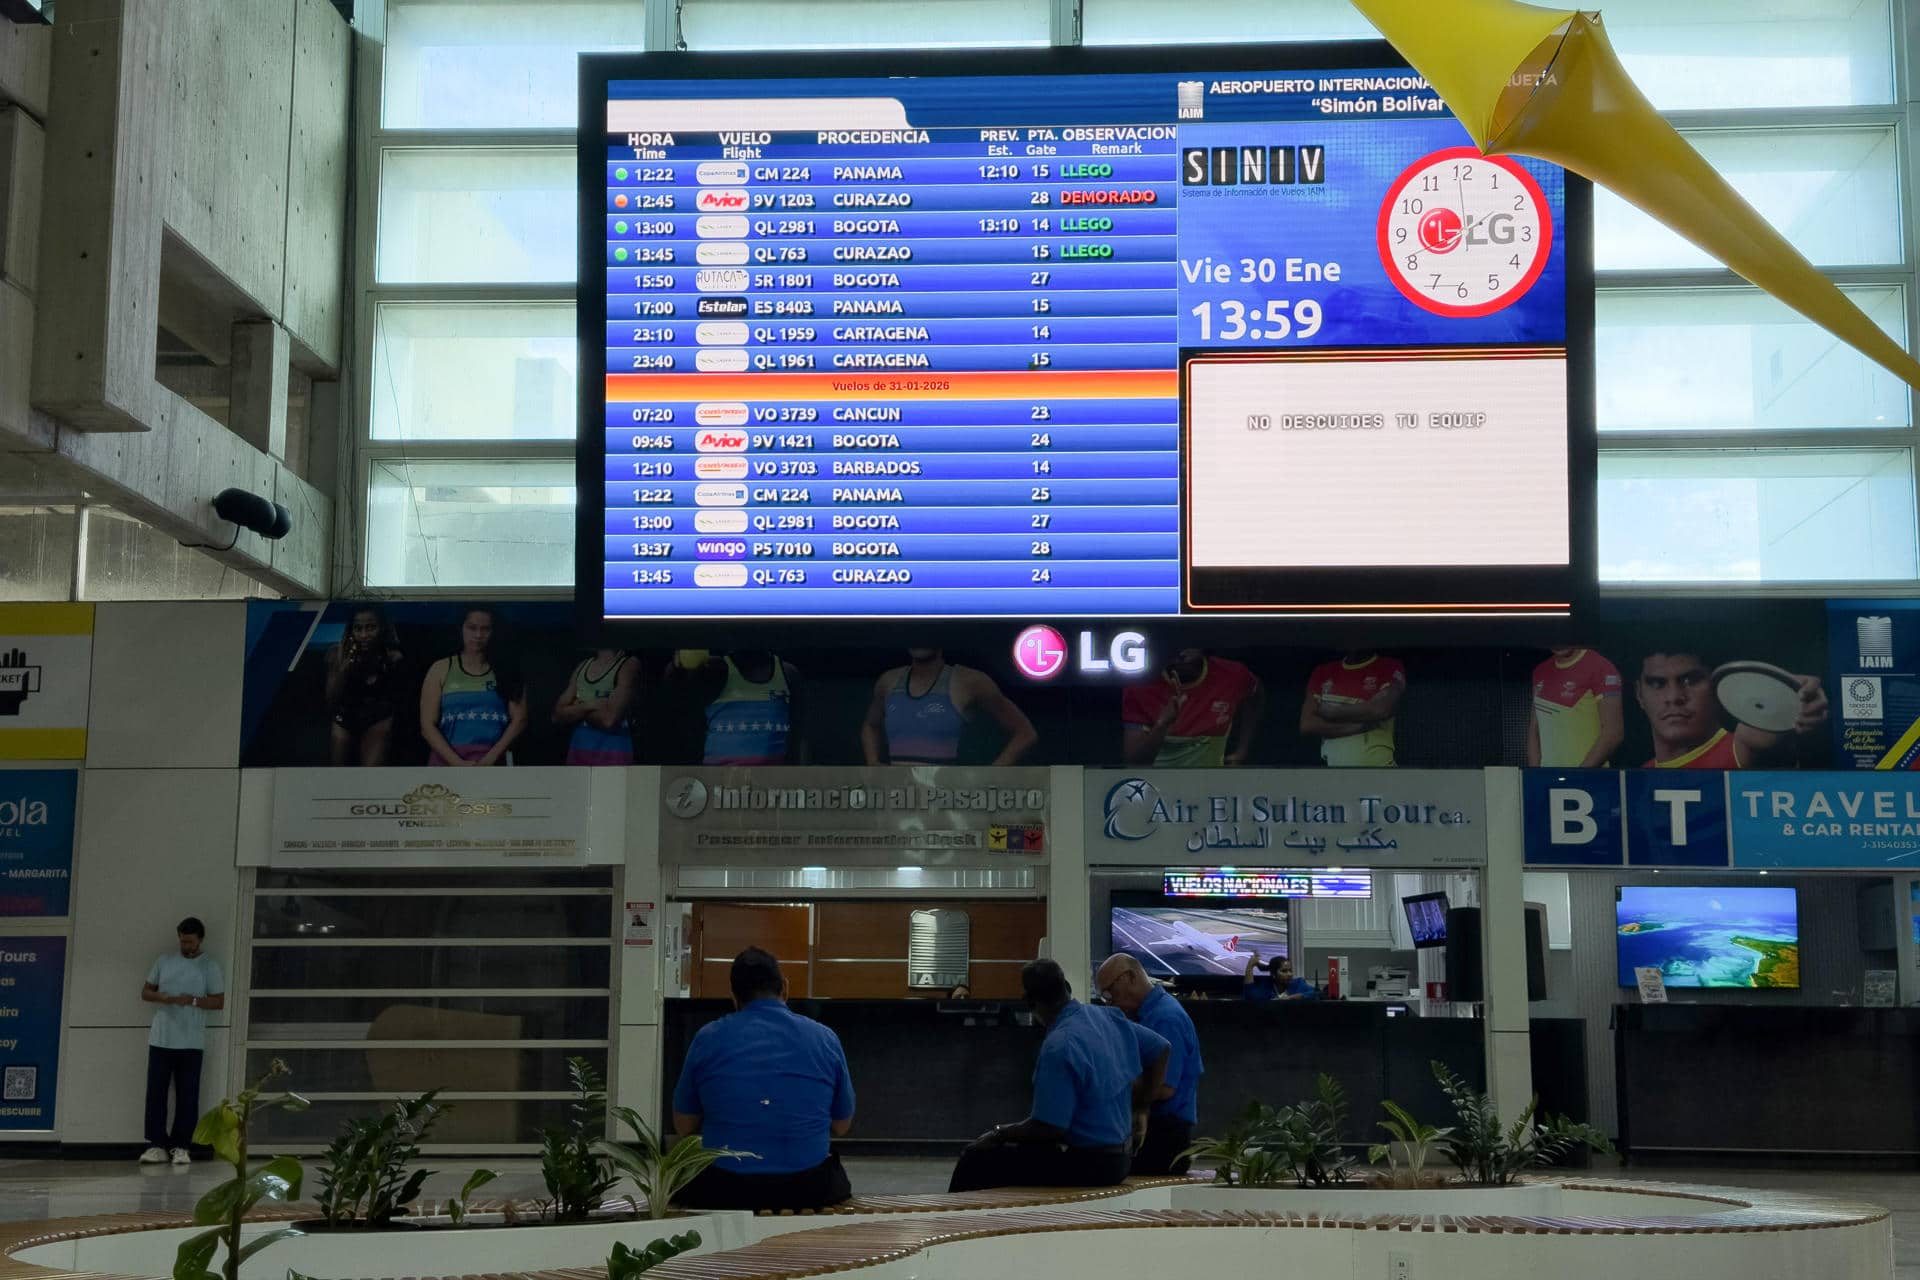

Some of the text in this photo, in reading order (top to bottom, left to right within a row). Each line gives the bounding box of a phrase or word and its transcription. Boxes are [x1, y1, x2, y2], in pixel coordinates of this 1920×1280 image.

[1210, 77, 1432, 94] AEROPUERTO INTERNACIONA
[1178, 108, 1203, 119] IAIM
[628, 127, 1176, 146] HORA VUELO PROCEDENCIA PREV. PTA. OBSERVACION
[634, 142, 1142, 161] Time Flight Est. Gate Remark
[634, 162, 1112, 182] 12:22 CM 224 PANAMA 12:10 15 LLEGO
[1453, 165, 1473, 181] 12
[1423, 176, 1439, 191] 11
[634, 189, 1156, 208] 12:45 Avior 9V 1203 CURAZAO 28 DEMORADO
[1402, 199, 1423, 214] 10
[634, 215, 1112, 236] 13:00 QL 2981 BOGOTA 13:10 14 LLEGO
[634, 242, 1112, 263] 13:45 QL 763 CURAZAO 15 LLEGO
[1181, 257, 1341, 283] Vie 30 Ene
[634, 274, 674, 288] 15:50
[754, 273, 774, 287] 5R
[777, 273, 812, 287] 1801
[833, 272, 900, 286] BOGOTA
[1030, 271, 1050, 285] 27
[1488, 274, 1499, 290] 5
[1457, 282, 1468, 298] 6
[633, 298, 1049, 315] 17:00 Estelar ES 8403 PANAMA 15
[1191, 299, 1323, 340] 13:59
[633, 325, 1050, 343] 23:10 QL 1959 CARTAGENA 14
[633, 351, 1050, 370] 23:40 QL 1961 CARTAGENA 15
[833, 380, 950, 391] Vuelos de 31-01-2026
[632, 407, 673, 422] 07:20
[753, 407, 778, 421] VO
[780, 407, 817, 421] 3739
[832, 407, 900, 421] CANCUN
[1031, 405, 1050, 419] 23
[1248, 412, 1486, 430] NO DESCUIDES TU EQUIP
[631, 432, 1050, 449] 09:45 Avior 9V 1421 BOGOTA 24
[632, 461, 673, 475] 12:10
[752, 461, 777, 475] VO
[780, 460, 816, 474] 3703
[832, 460, 920, 474] BARBADOS
[1031, 459, 1050, 473] 14
[632, 486, 1050, 502] 12:22 CM 224 PANAMA 25
[632, 513, 1050, 531] 13:00 QL 2981 BOGOTA 27
[631, 541, 1050, 556] 13:37 wingo P5 7010 BOGOTA 28
[631, 568, 1050, 585] 13:45 QL 763 CURAZAO 24
[1080, 631, 1146, 671] LG
[1859, 656, 1894, 668] IAIM
[713, 784, 1044, 812] Información al Pasajero
[350, 804, 440, 816] GOLDEN
[1147, 795, 1435, 824] Air El Sultan Tour
[1549, 788, 1701, 846] B T
[1782, 823, 1842, 836] & CAR
[1187, 826, 1269, 852] السلطان
[1336, 828, 1398, 853] مكتب
[9, 869, 69, 879] MARGARITA
[1170, 875, 1310, 895] VUELOS NACIONALES
[911, 973, 967, 985] IAIM
